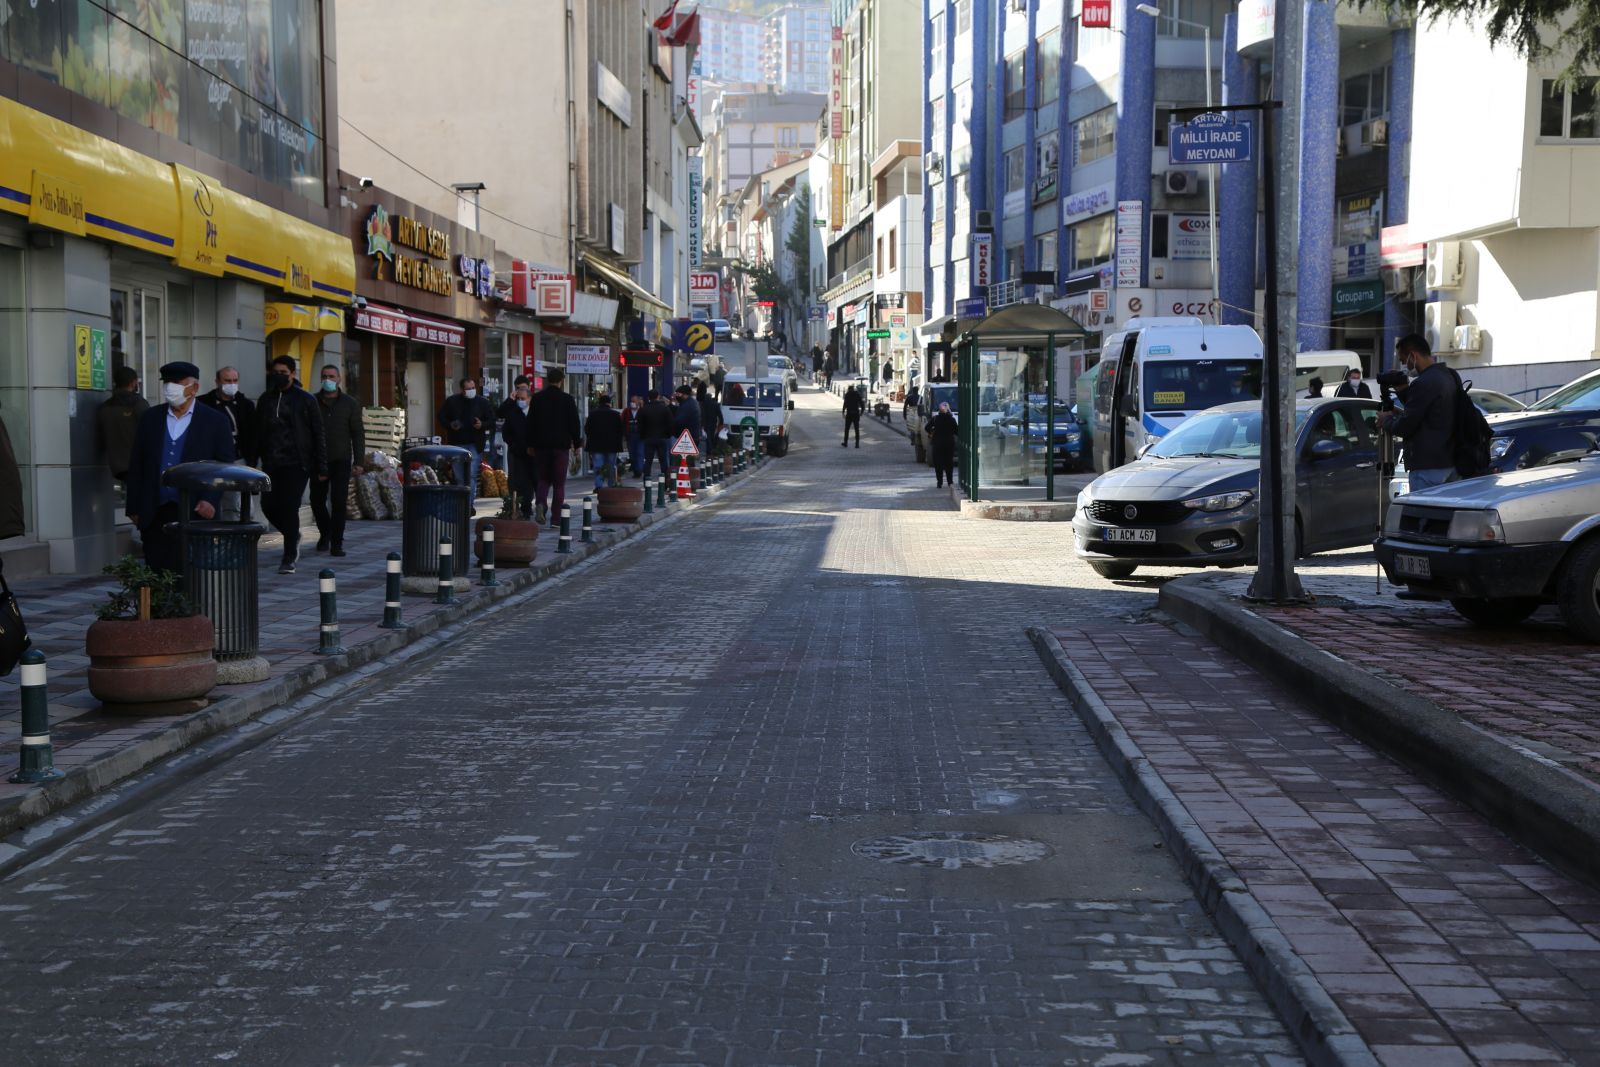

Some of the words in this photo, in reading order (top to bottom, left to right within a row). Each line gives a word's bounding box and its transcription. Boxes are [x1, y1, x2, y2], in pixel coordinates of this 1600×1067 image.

[832, 47, 841, 107] MHP
[1193, 114, 1228, 126] ARTVİN
[259, 107, 276, 139] Türk
[276, 117, 305, 153] Telekom
[1179, 130, 1208, 144] MİLLİ
[1210, 129, 1243, 144] İRADE
[1186, 148, 1237, 161] MEYDANI
[205, 219, 218, 249] Ptt
[690, 232, 698, 266] KURSU
[395, 254, 422, 290] MEYVE
[544, 288, 561, 309] E
[1094, 294, 1105, 308] E
[1336, 289, 1376, 304] Groupama
[1108, 529, 1117, 540] 61
[1120, 529, 1136, 541] ACM
[1139, 529, 1155, 541] 467
